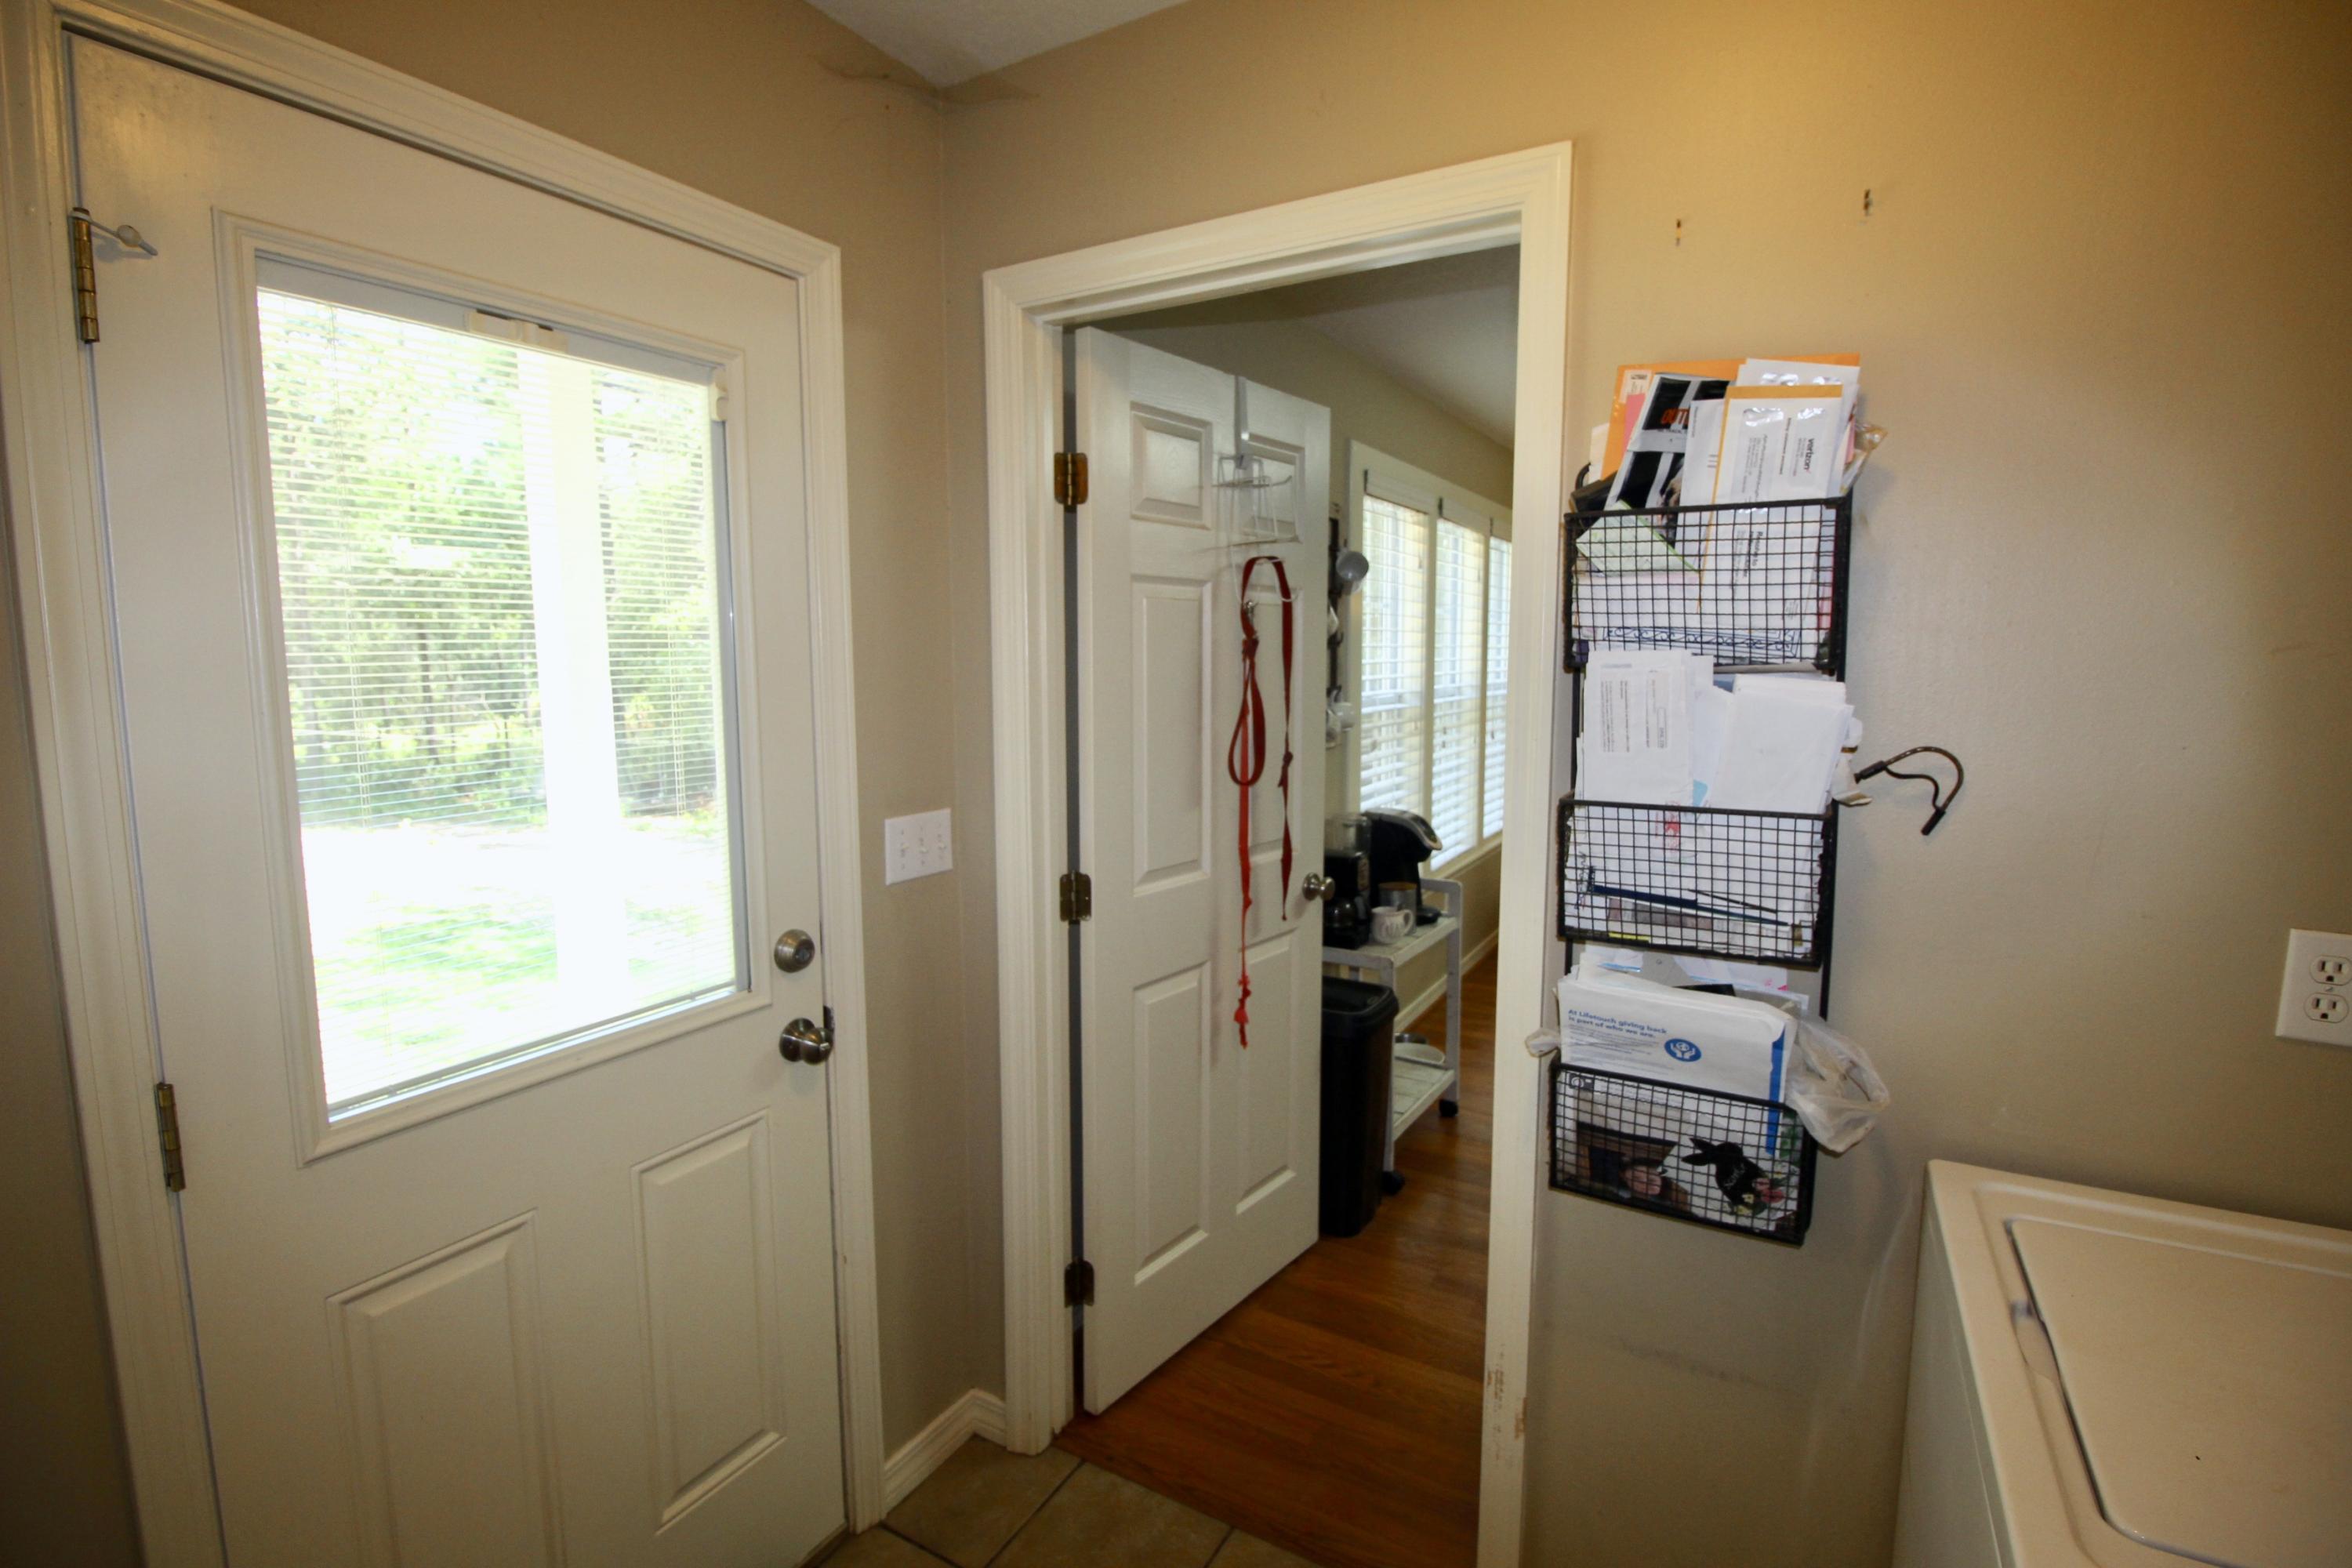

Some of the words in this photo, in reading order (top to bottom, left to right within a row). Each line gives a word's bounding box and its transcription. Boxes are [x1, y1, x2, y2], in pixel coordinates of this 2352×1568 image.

[1803, 438, 1815, 470] verizon
[1577, 1018, 1593, 1026] part
[1579, 1011, 1617, 1024] Lifetouch
[1618, 1020, 1645, 1030] giving
[1646, 1025, 1668, 1034] back
